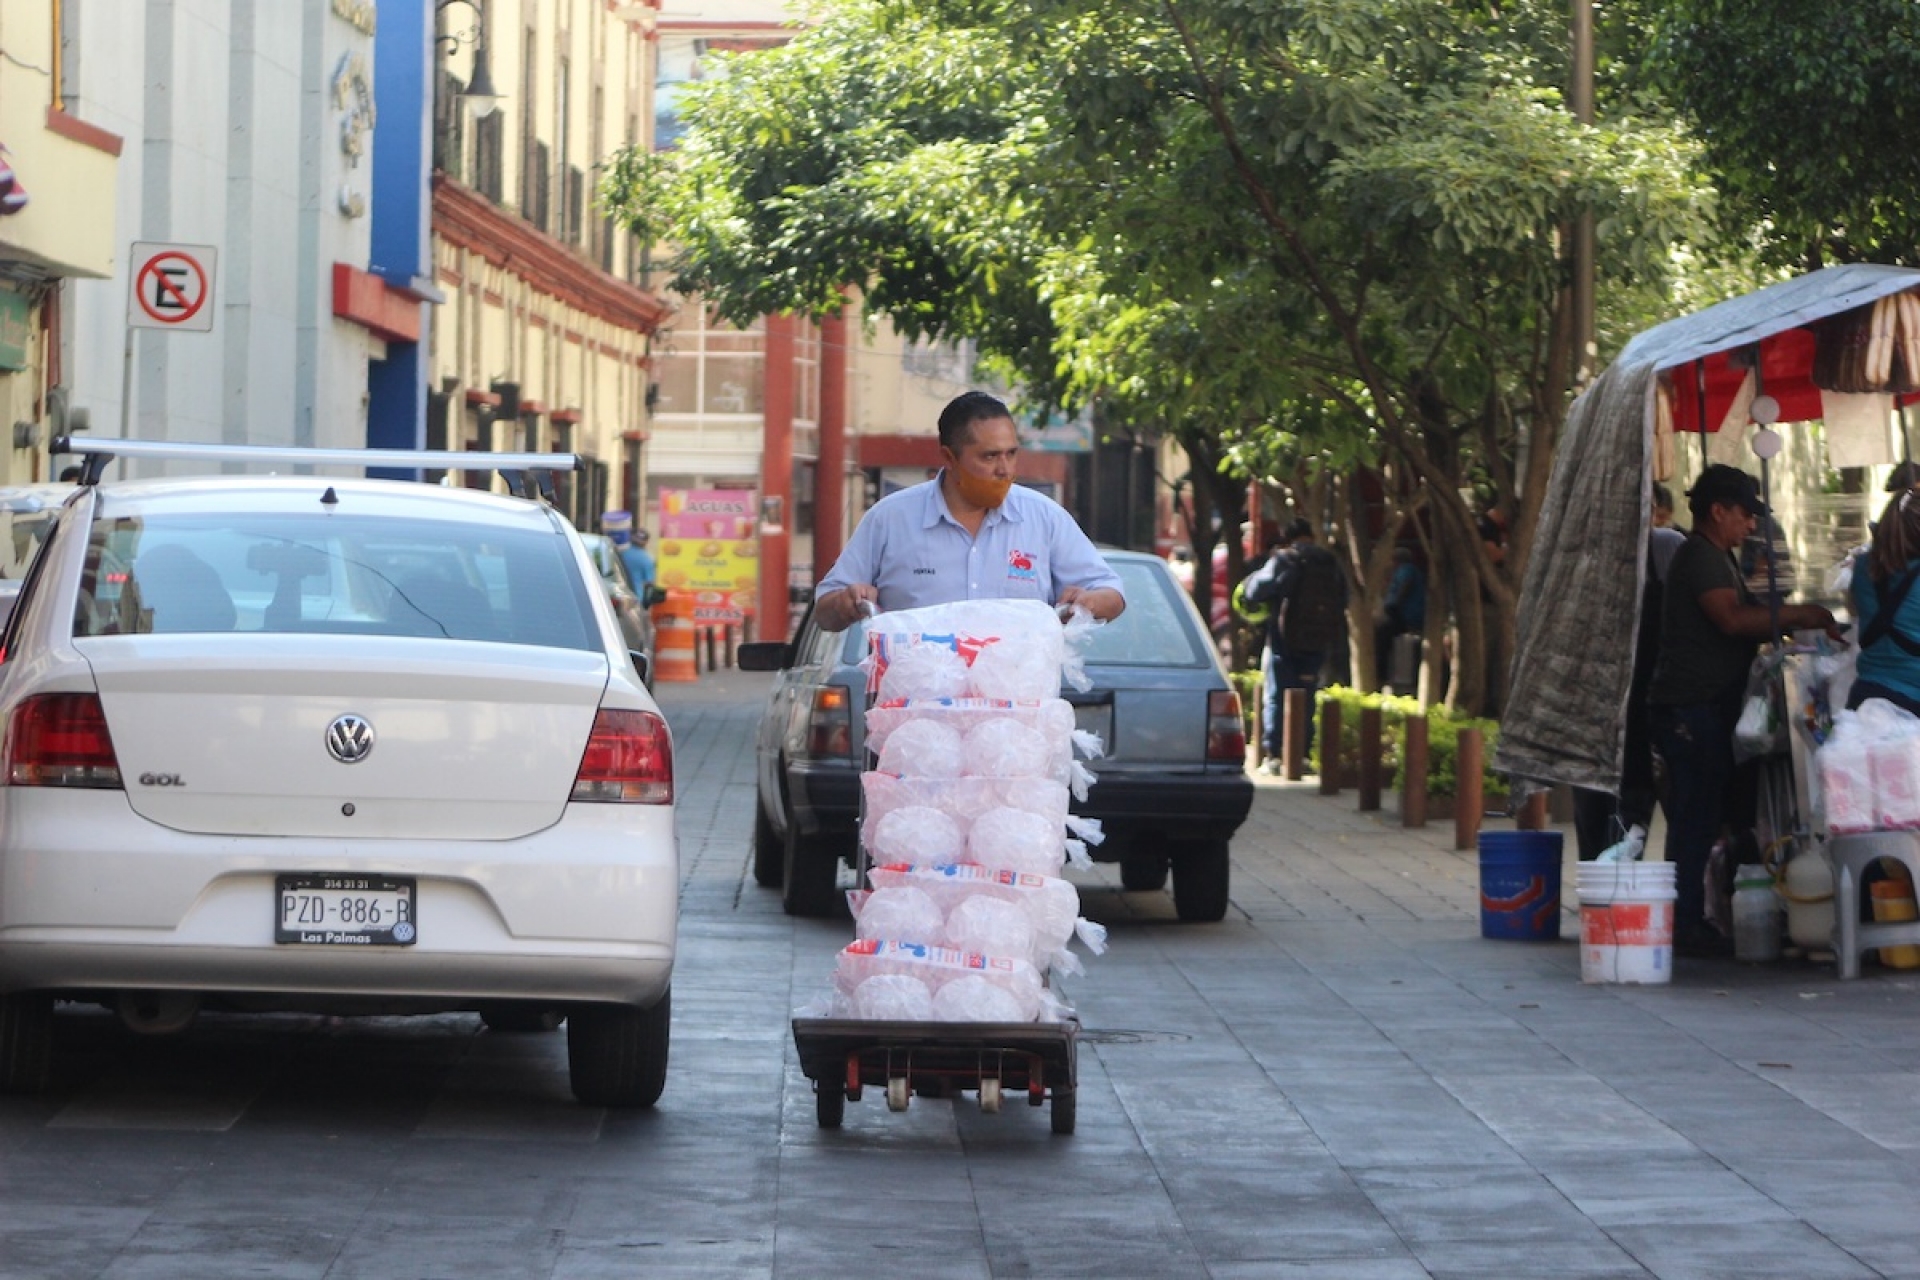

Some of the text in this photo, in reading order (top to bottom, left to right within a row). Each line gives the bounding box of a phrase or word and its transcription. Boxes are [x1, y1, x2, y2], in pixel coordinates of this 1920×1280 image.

[155, 268, 188, 308] E
[688, 501, 744, 513] AGUAS
[694, 607, 743, 619] REPAS
[139, 773, 186, 786] GOL
[324, 880, 341, 889] 314
[283, 895, 409, 923] PZD-886-B
[301, 932, 371, 944] Las Palmas
